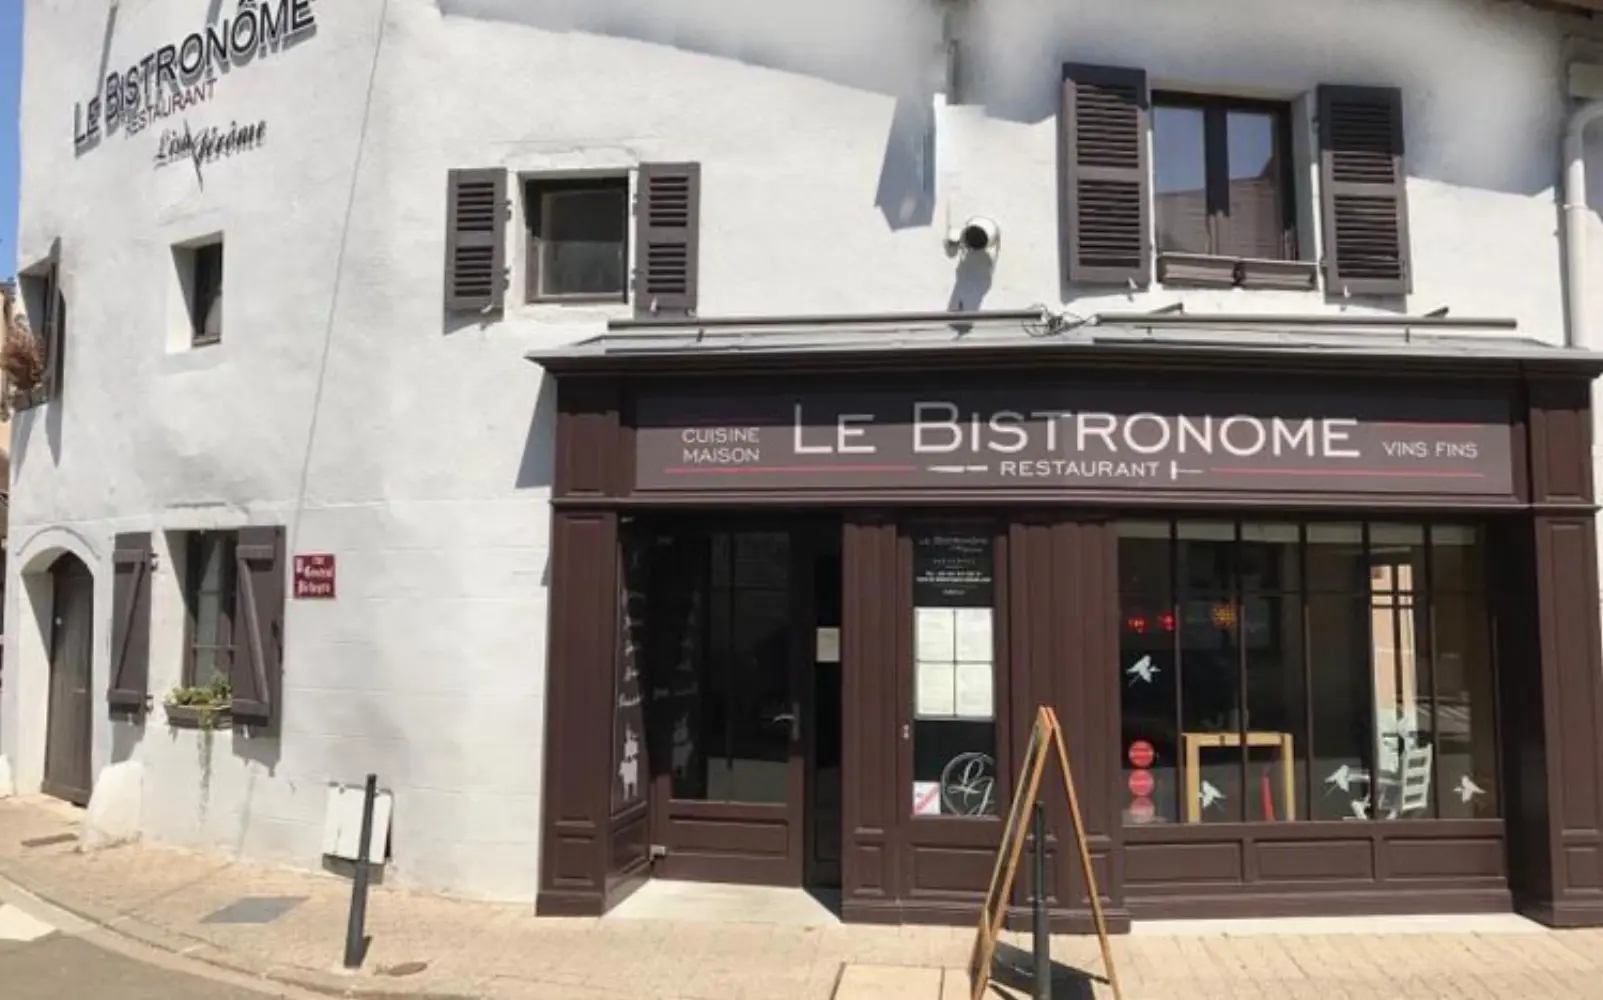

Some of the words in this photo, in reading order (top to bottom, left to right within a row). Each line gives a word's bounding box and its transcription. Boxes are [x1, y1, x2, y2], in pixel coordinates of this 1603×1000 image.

[125, 78, 217, 139] RESTAURANT
[74, 96, 99, 145] LE
[682, 427, 760, 443] CUISINE
[794, 403, 877, 455] LE
[913, 401, 1361, 458] BISTRONOME
[682, 447, 760, 463] MAISON
[1382, 440, 1428, 458] VINS
[1436, 440, 1479, 459] FINS
[999, 460, 1160, 478] RESTAURANT
